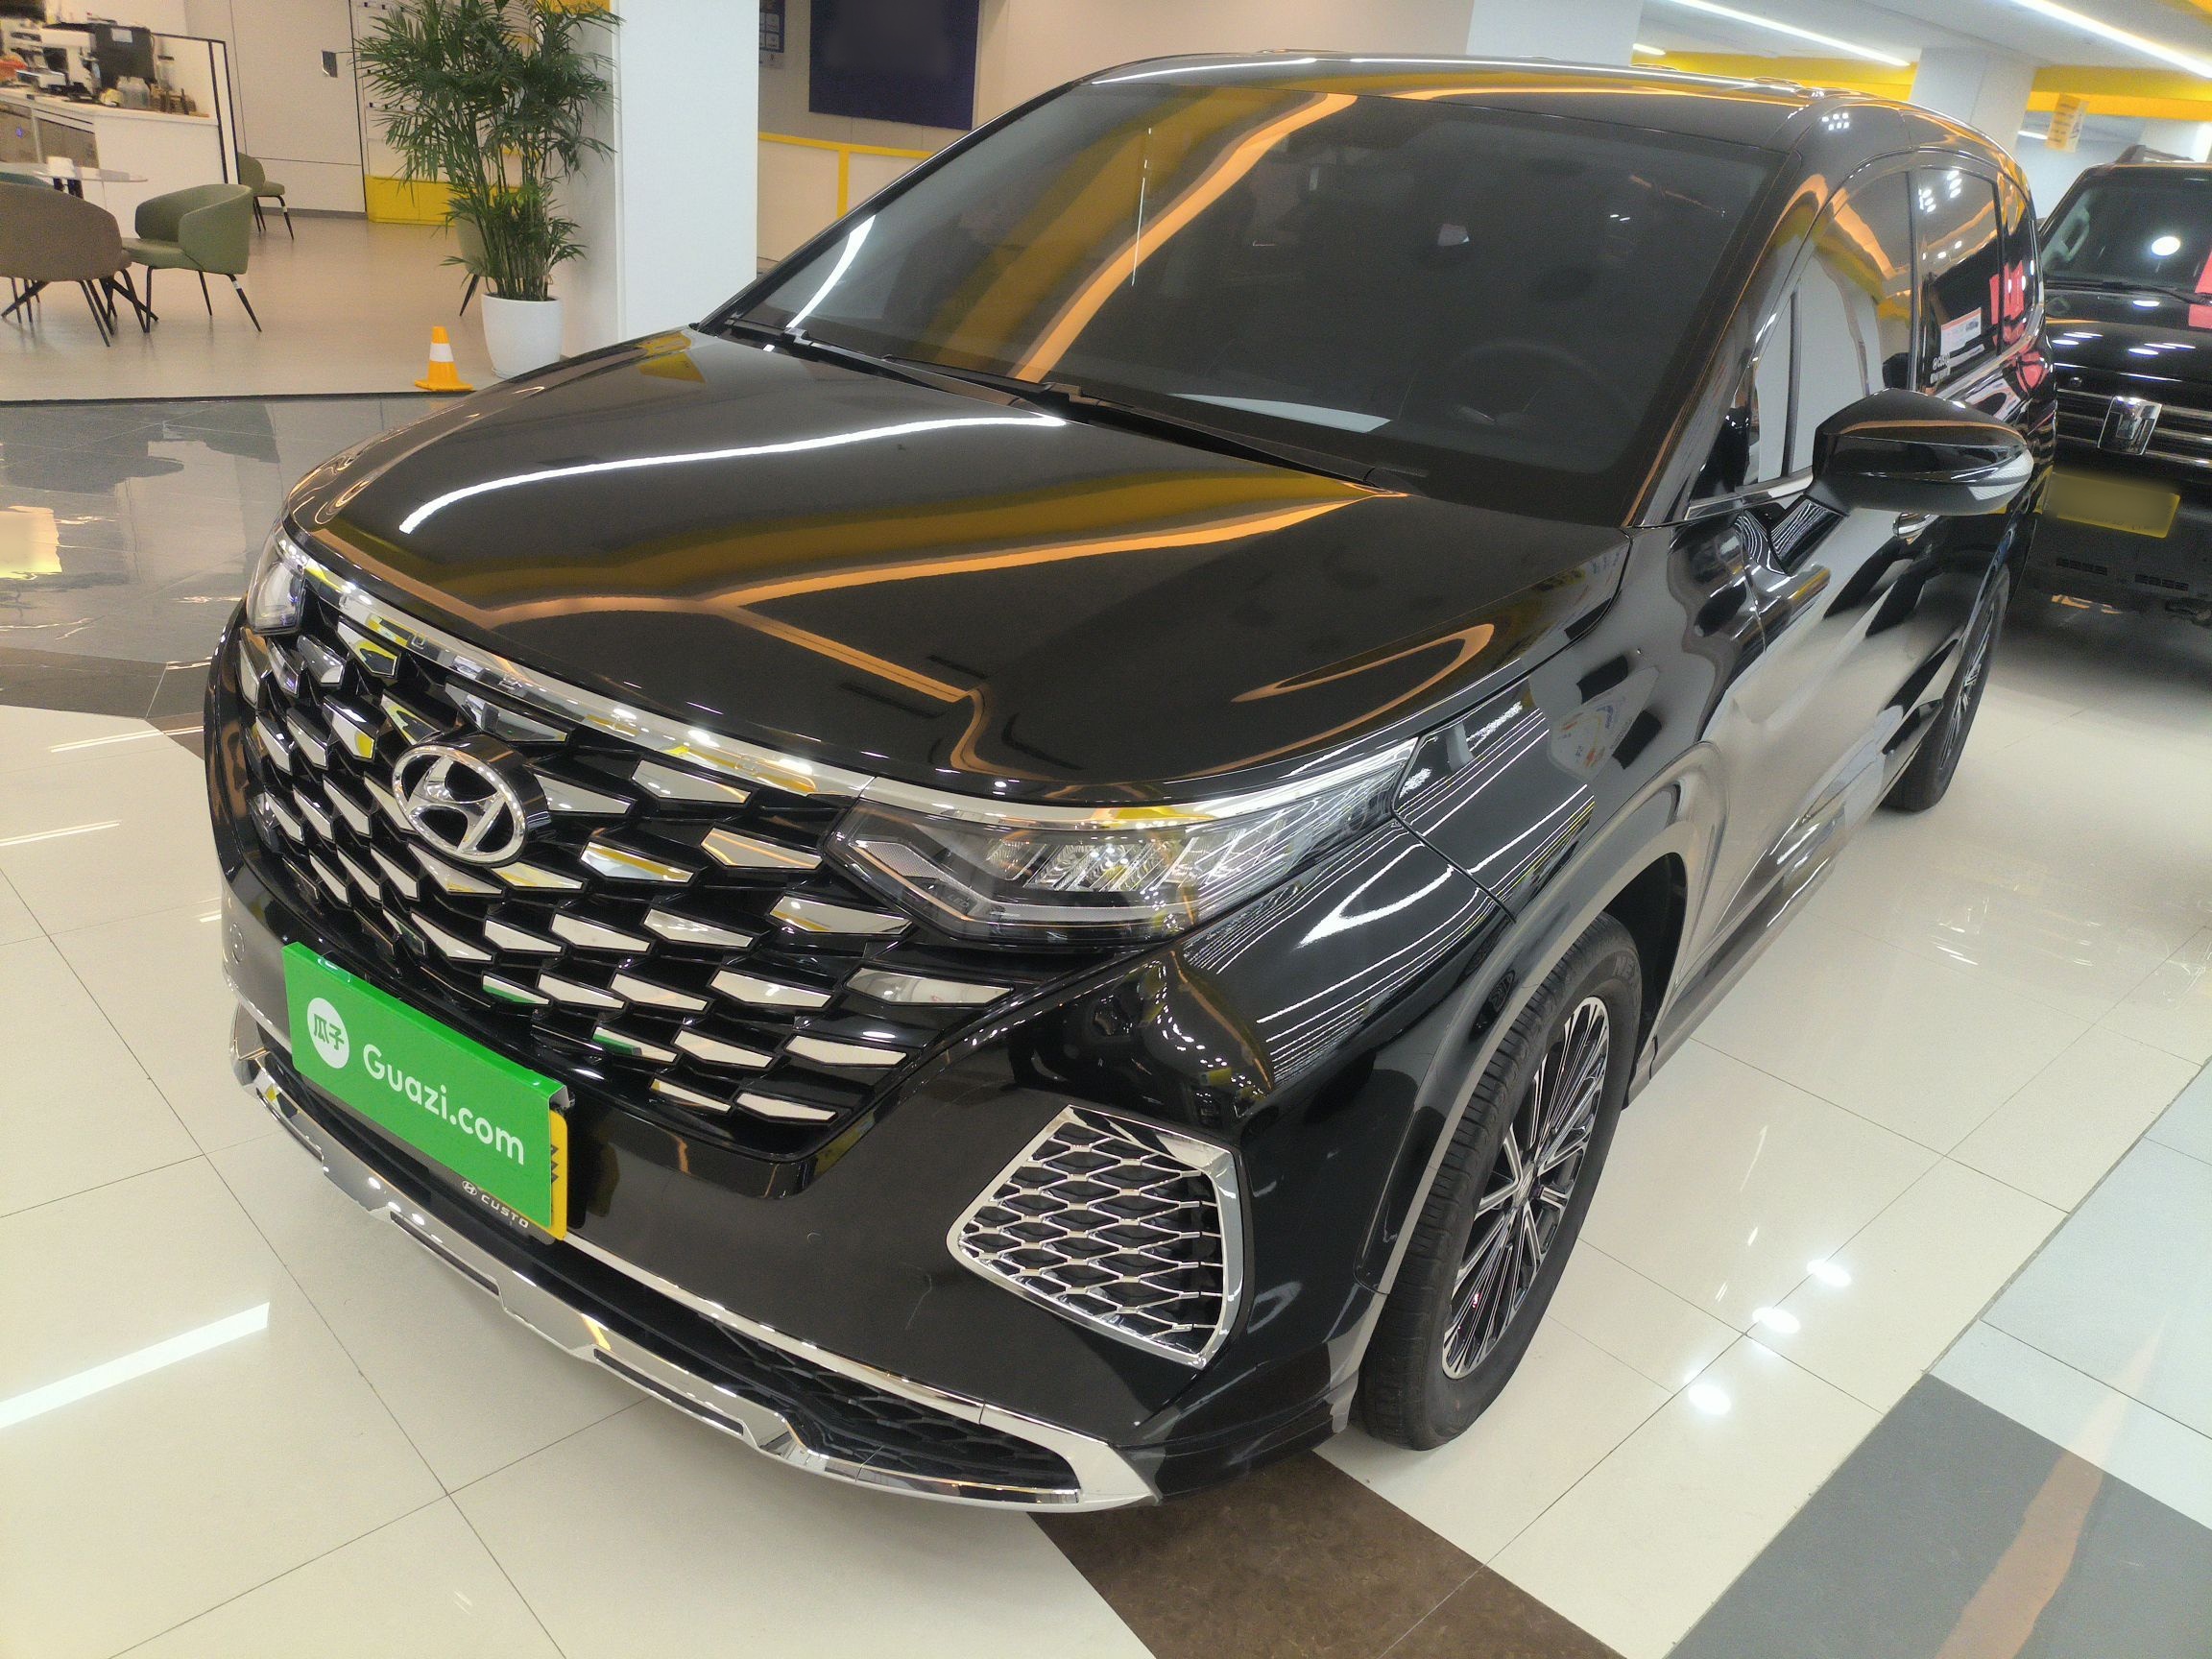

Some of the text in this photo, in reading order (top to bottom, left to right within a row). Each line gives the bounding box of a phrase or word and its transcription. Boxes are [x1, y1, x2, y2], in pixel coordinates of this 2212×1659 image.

[313, 1013, 345, 1050] 瓜子
[363, 1044, 524, 1166] Guazi.com
[481, 1193, 529, 1229] CUSTO
